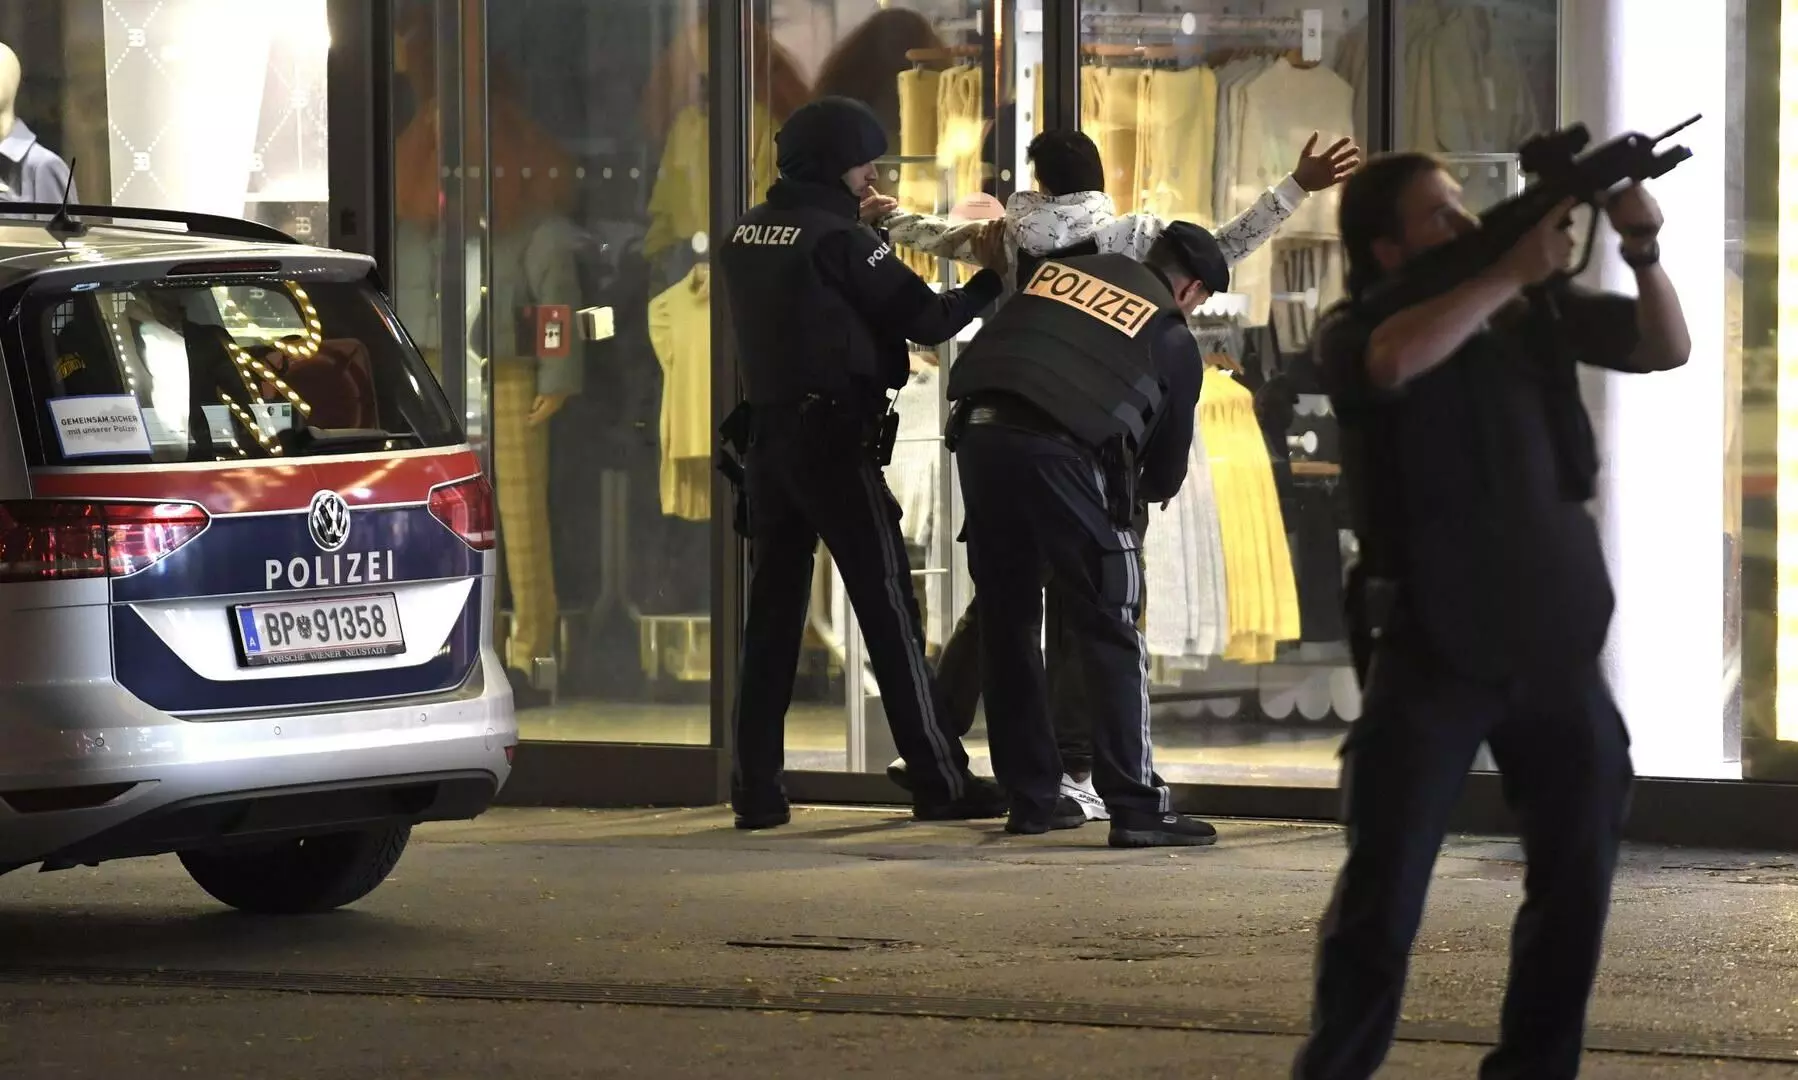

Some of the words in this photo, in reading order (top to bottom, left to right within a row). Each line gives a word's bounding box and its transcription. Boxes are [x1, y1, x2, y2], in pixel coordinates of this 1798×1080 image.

[732, 224, 802, 245] POLIZEI
[1029, 265, 1151, 331] POLIZEI
[67, 427, 81, 435] mit
[82, 425, 111, 434] unserer
[113, 425, 137, 433] Polizei
[265, 550, 393, 590] POLIZEI
[249, 638, 256, 647] A
[264, 611, 295, 646] BP
[312, 604, 387, 642] 91358
[267, 655, 305, 664] PORSCHE
[311, 651, 341, 660] WIENER
[345, 648, 387, 657] NEUSTADT
